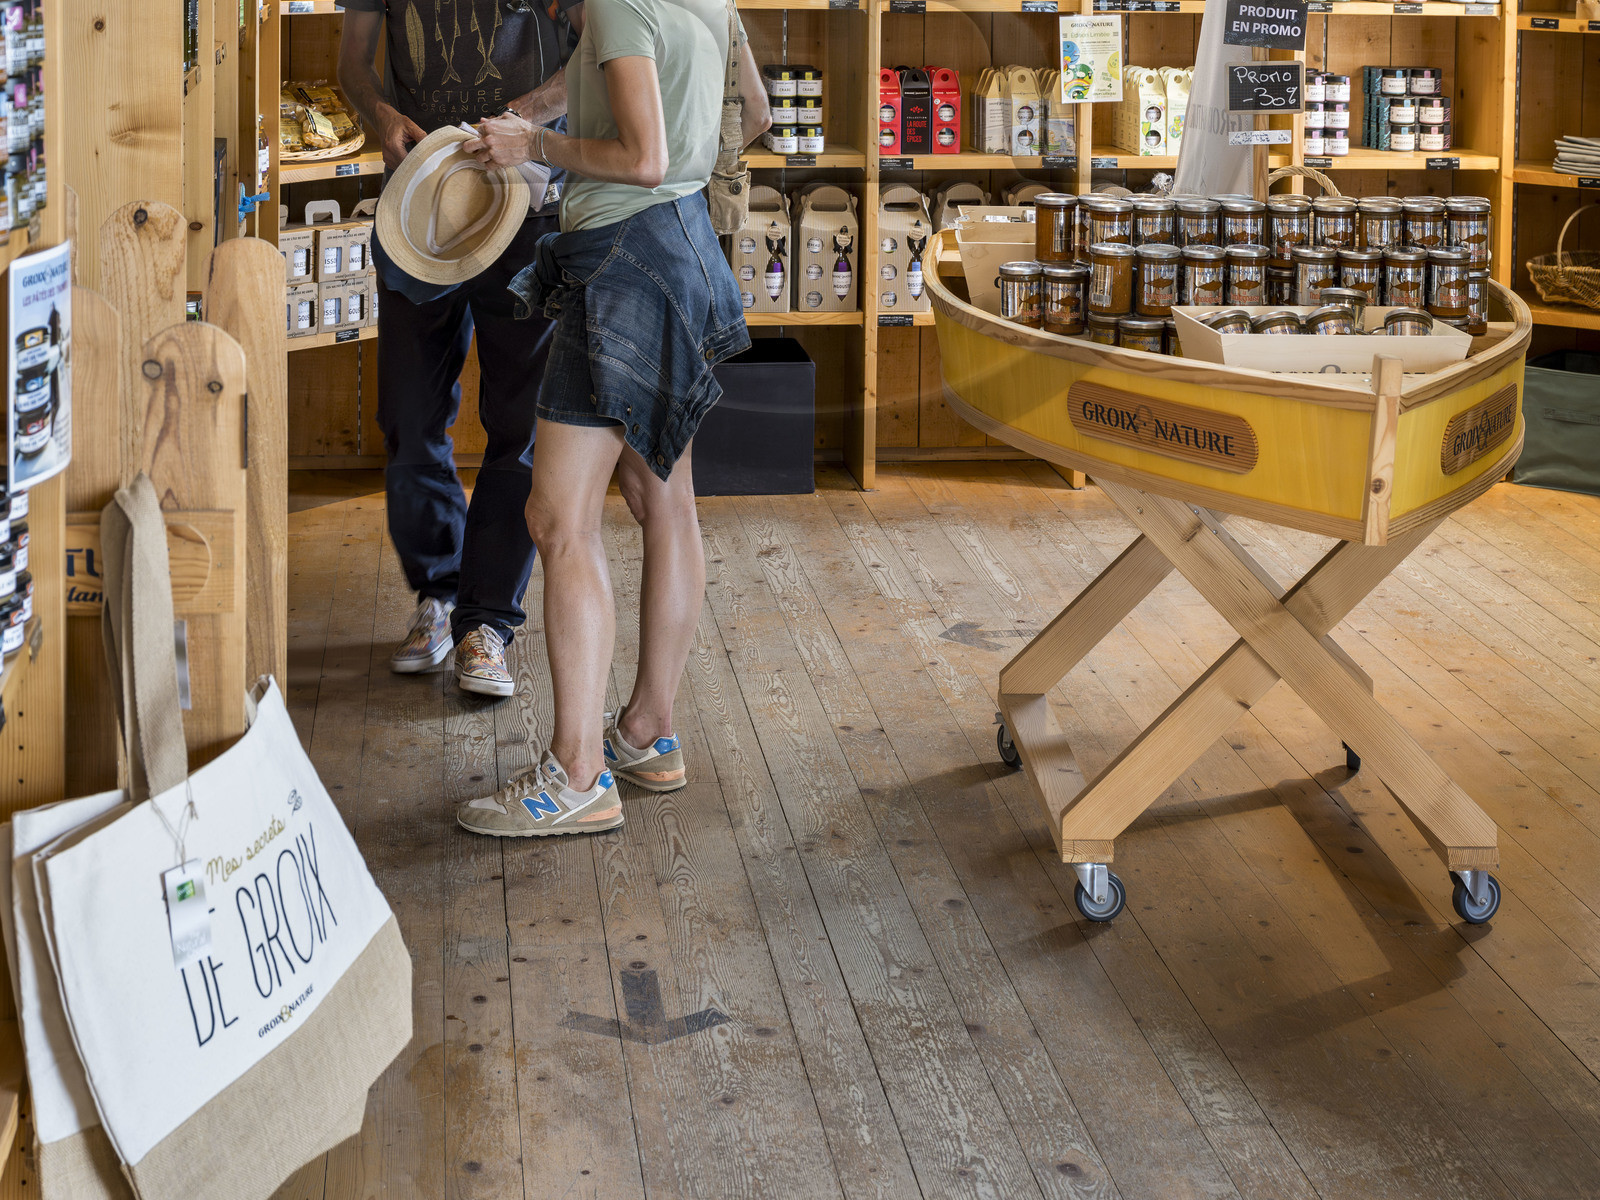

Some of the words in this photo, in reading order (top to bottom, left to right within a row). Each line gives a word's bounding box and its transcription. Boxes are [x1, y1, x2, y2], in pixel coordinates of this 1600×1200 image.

[1232, 20, 1250, 33] EN
[1252, 22, 1302, 37] PROMO
[1239, 4, 1298, 20] PRODUIT
[906, 135, 922, 143] ÉPICES
[1082, 400, 1139, 434] GROIX
[1154, 418, 1236, 457] NATURE
[1453, 423, 1481, 457] GROIX
[1486, 403, 1513, 437] NATURE
[520, 790, 562, 822] N
[206, 853, 243, 886] Mes
[246, 814, 286, 860] secrets
[235, 822, 338, 999] GROIX
[258, 1014, 284, 1039] GROIX
[288, 983, 315, 1014] NATURE
